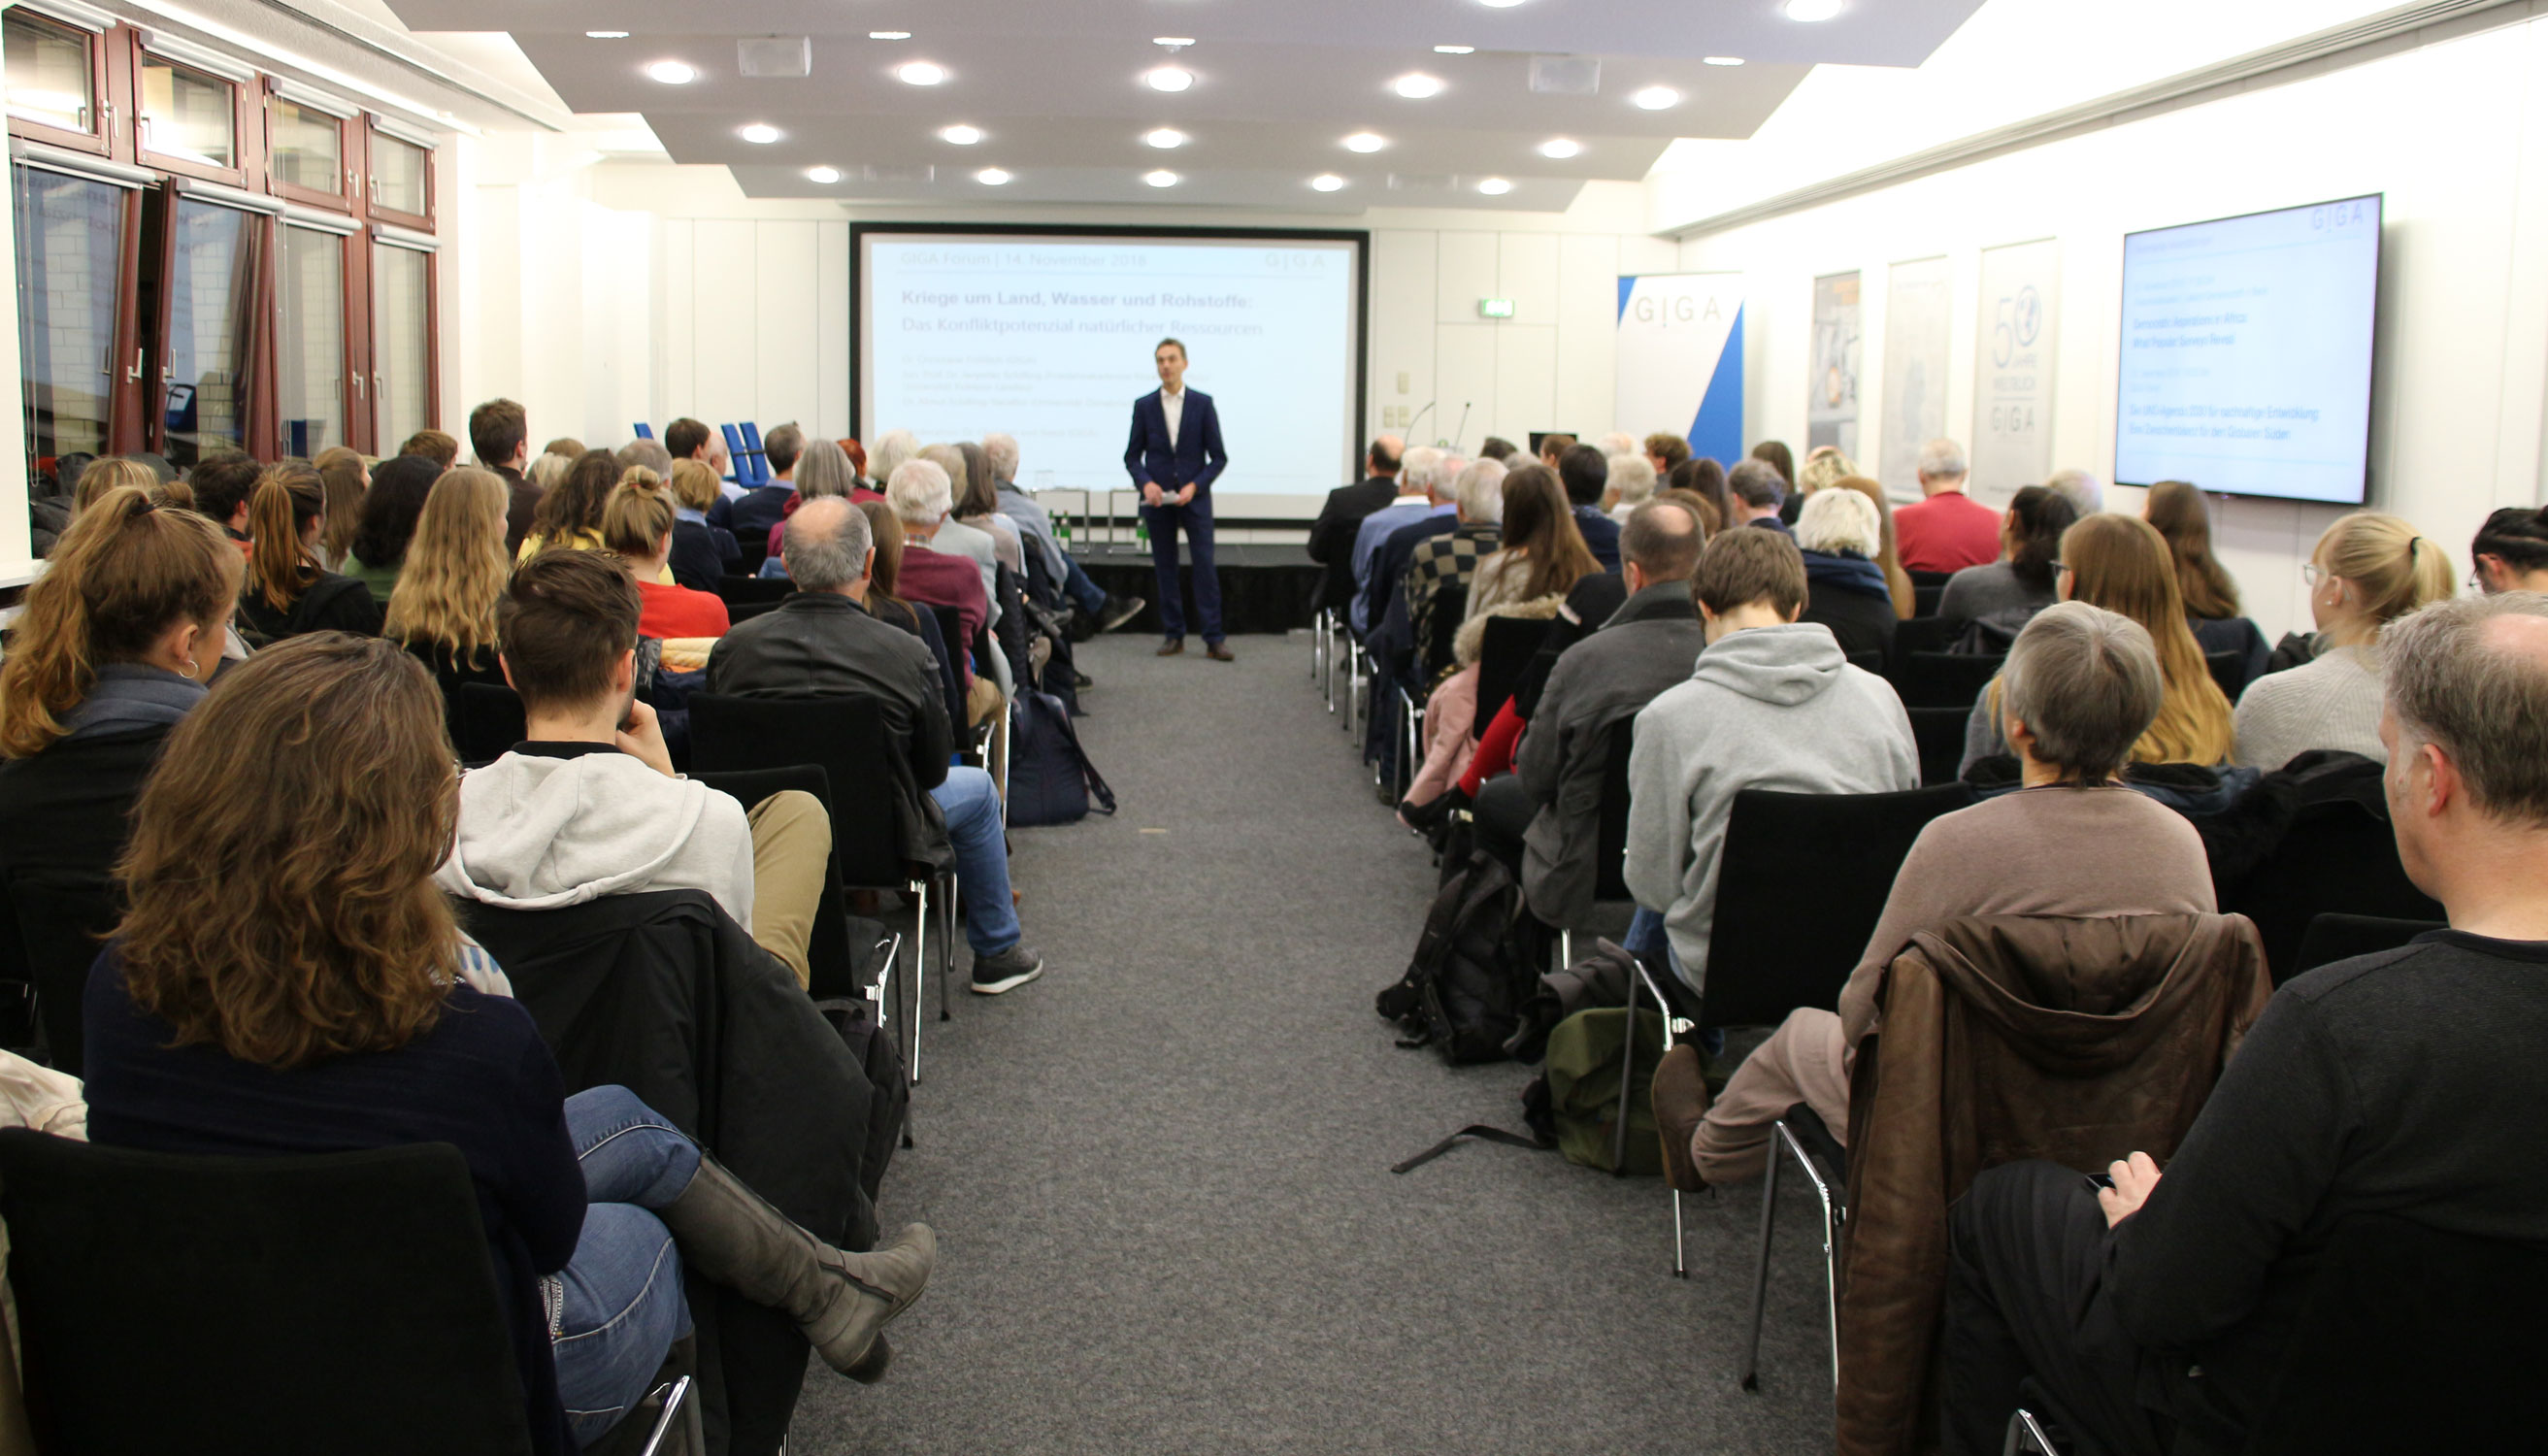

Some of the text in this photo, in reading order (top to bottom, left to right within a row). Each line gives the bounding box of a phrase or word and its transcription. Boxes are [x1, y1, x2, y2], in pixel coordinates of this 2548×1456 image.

[2313, 202, 2364, 233] GIGA
[900, 252, 939, 265] GIGA
[943, 252, 991, 265] Forum
[1029, 252, 1105, 266] November
[1110, 254, 1147, 267] 2018
[1264, 252, 1326, 271] GIGA
[902, 290, 1254, 309] Kriege um Land, Wasser und Rohstoffe:
[1635, 295, 1722, 328] GIGA
[902, 317, 1264, 336] Das Konfliktpotenzial natürlicher Ressourcen
